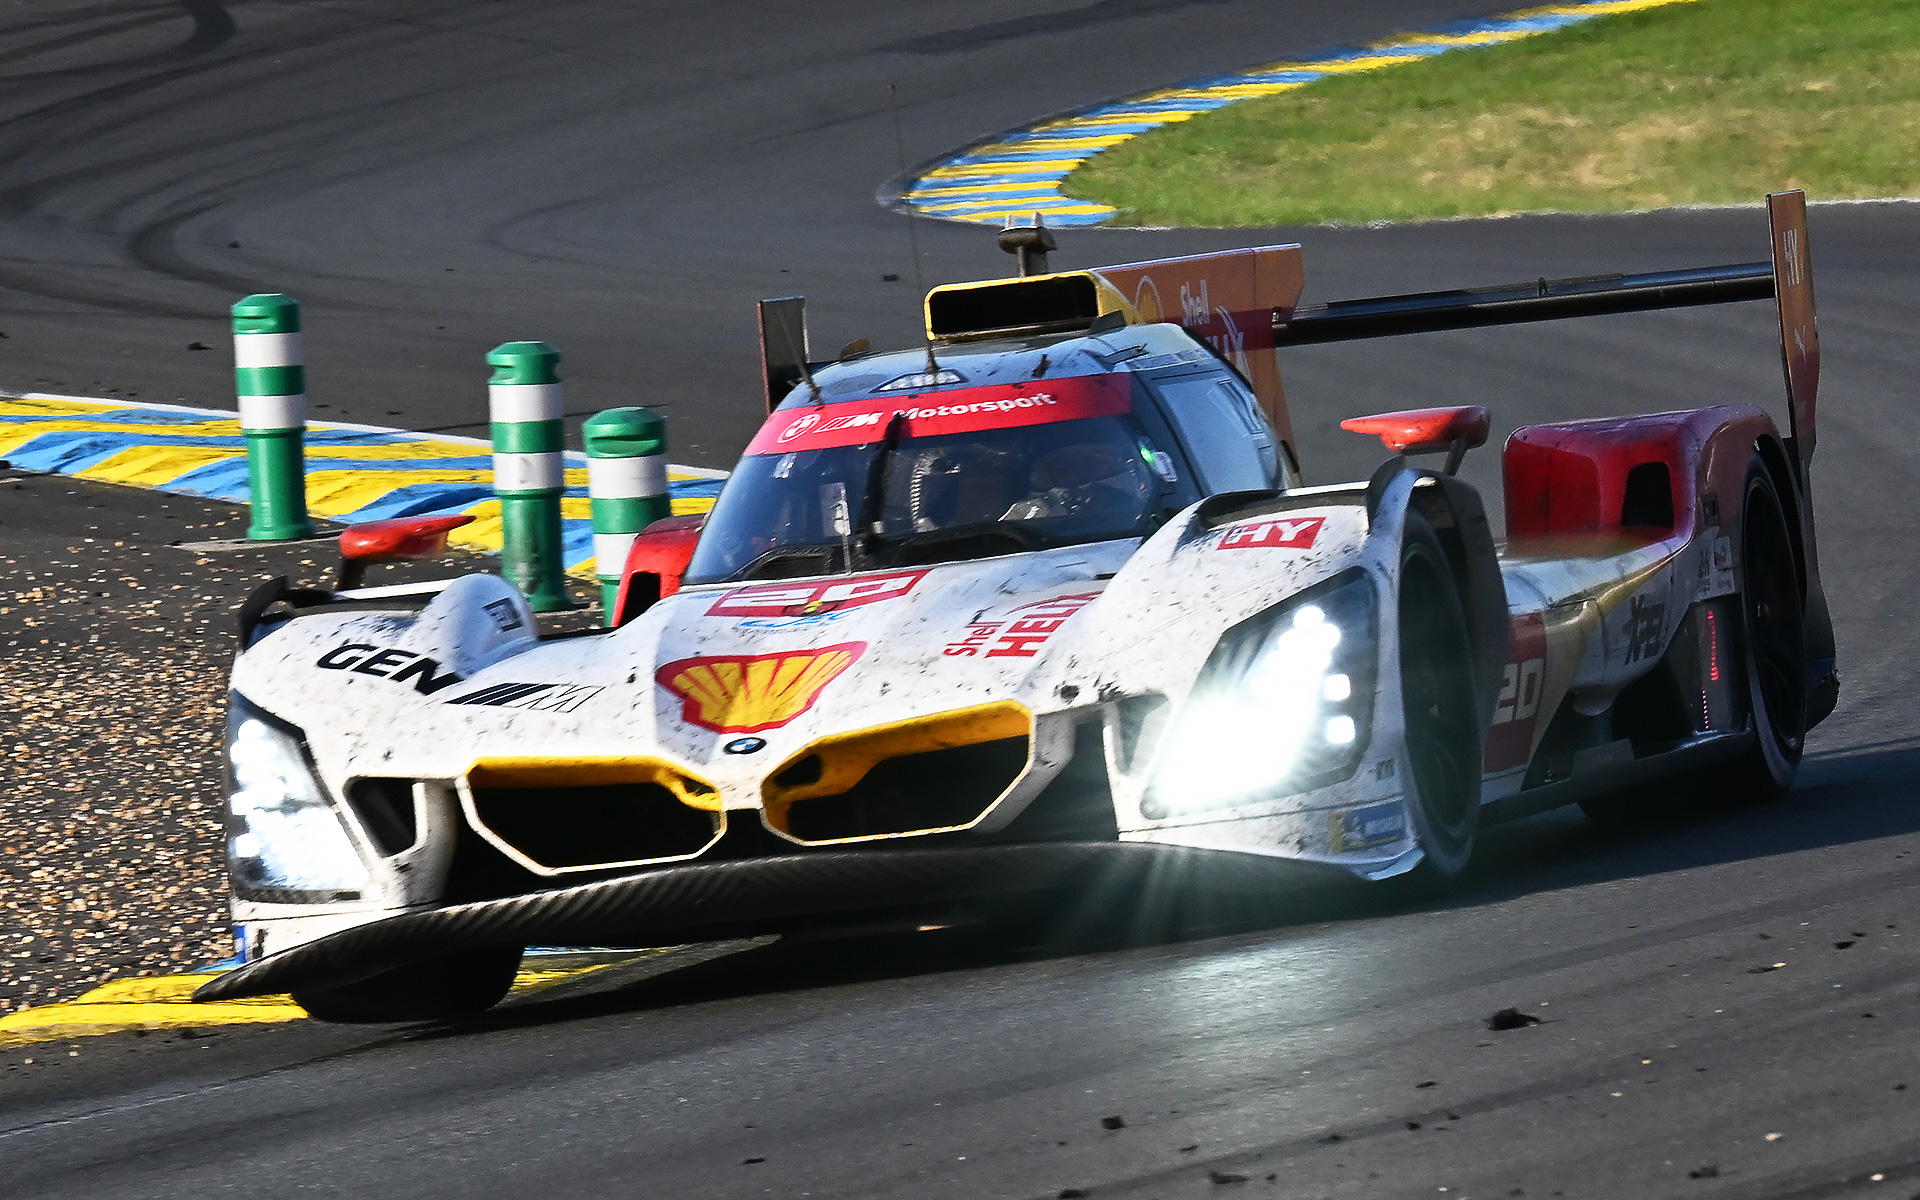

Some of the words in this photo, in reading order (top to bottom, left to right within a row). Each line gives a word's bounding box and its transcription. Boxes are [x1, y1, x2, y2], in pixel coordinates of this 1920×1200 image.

[892, 392, 1057, 421] Motorsport
[1225, 520, 1319, 545] HY
[719, 575, 917, 608] 20
[943, 621, 1007, 657] Shell
[317, 644, 465, 695] GEN
[1493, 658, 1544, 725] 20
